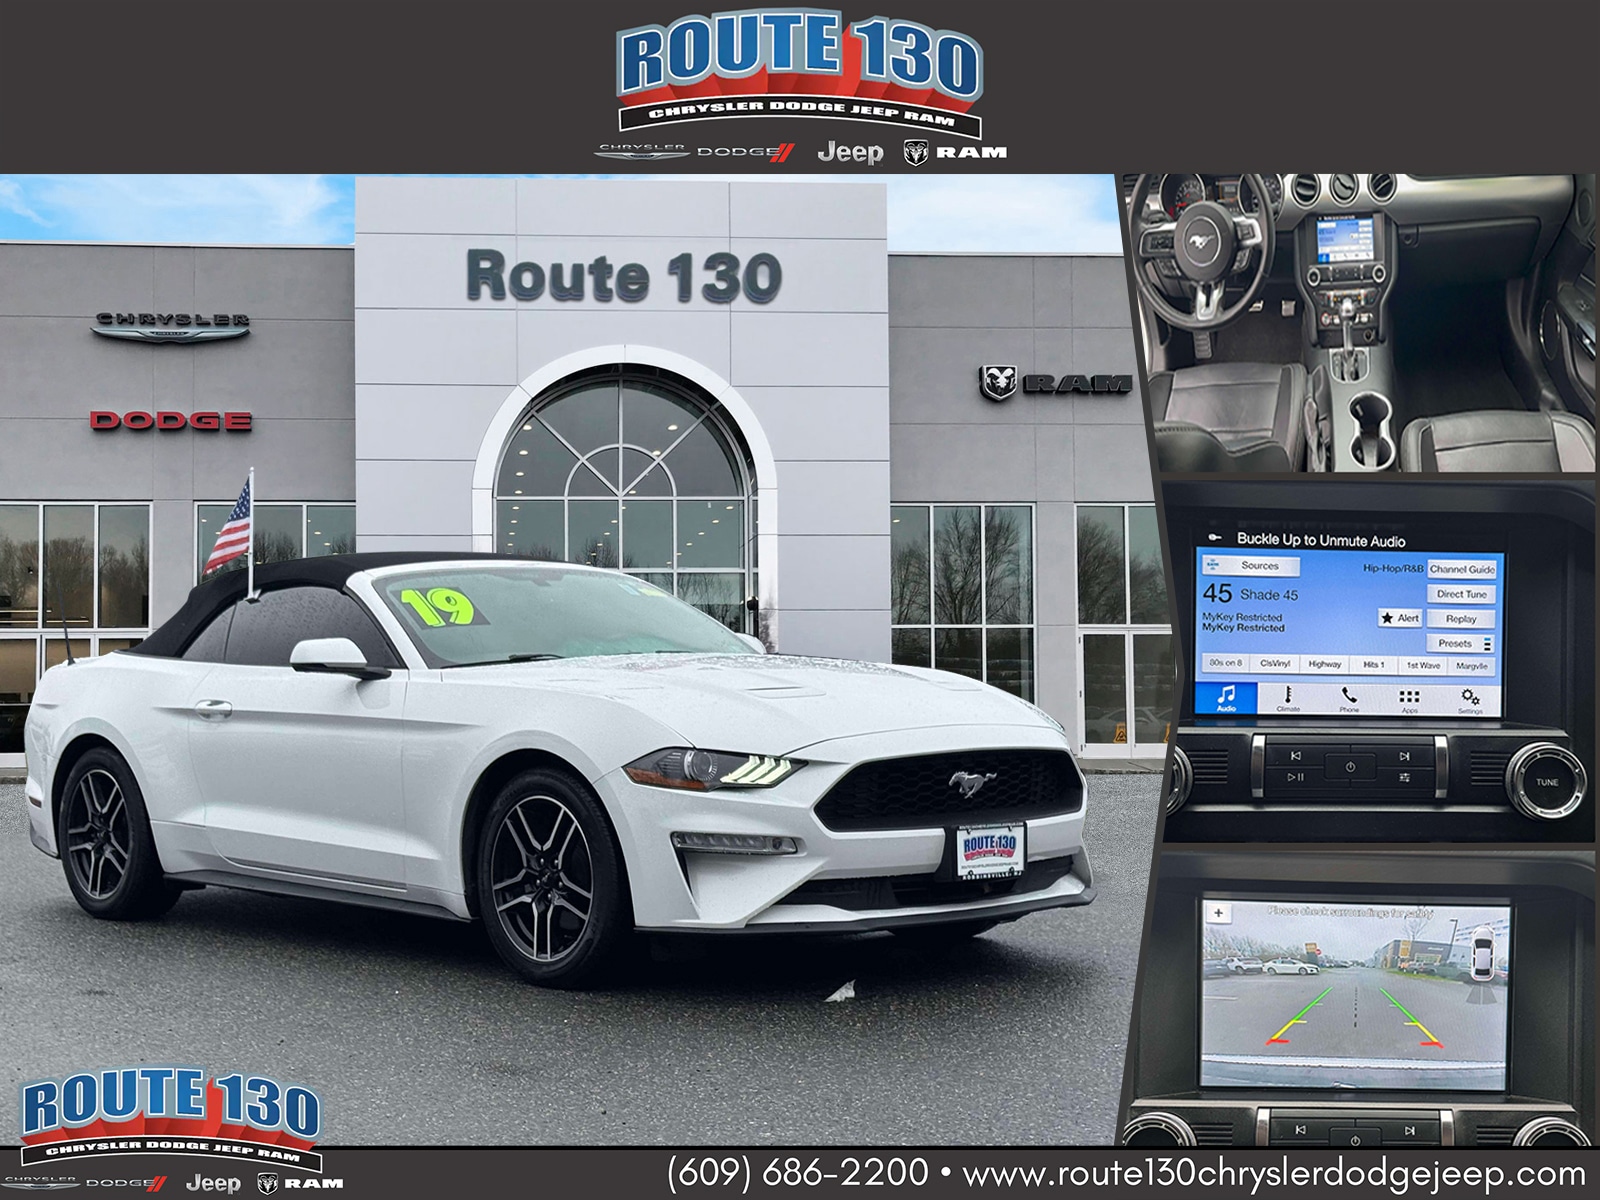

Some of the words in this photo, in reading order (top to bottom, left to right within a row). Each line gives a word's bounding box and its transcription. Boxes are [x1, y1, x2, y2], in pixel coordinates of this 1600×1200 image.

[466, 248, 650, 302] Route
[668, 252, 783, 304] 130
[96, 312, 250, 325] CHRYSLER
[1023, 374, 1133, 394] RAM
[89, 411, 252, 431] DODGE
[1237, 532, 1280, 545] Buckle
[1283, 533, 1301, 547] Up
[1304, 534, 1317, 546] to
[1320, 534, 1368, 547] Unmute
[1370, 535, 1406, 548] Audio
[1241, 560, 1279, 570] Sources
[1363, 564, 1424, 574] Hip-Hop/R&B
[1430, 564, 1467, 574] Channel
[1469, 565, 1495, 574] Guide
[1203, 583, 1232, 603] 45
[1240, 588, 1280, 601] Shade
[1283, 589, 1299, 601] 45
[1437, 589, 1464, 599] Direct
[1466, 590, 1488, 599] Tune
[401, 587, 475, 627] 19
[1202, 612, 1234, 622] MyKey
[1236, 612, 1283, 622] Restricted
[1398, 613, 1419, 623] Alert
[1446, 614, 1477, 625] Replay
[1202, 623, 1234, 633] MyKey
[1237, 623, 1285, 633] Restricted
[1438, 639, 1472, 648] Presets
[1308, 660, 1342, 670] Highway
[1363, 661, 1379, 669] Hits
[1407, 661, 1418, 669] 1st
[1419, 662, 1441, 670] Wave
[1536, 778, 1560, 787] TUNE
[963, 835, 995, 854] ROUTE
[997, 834, 1016, 850] 130
